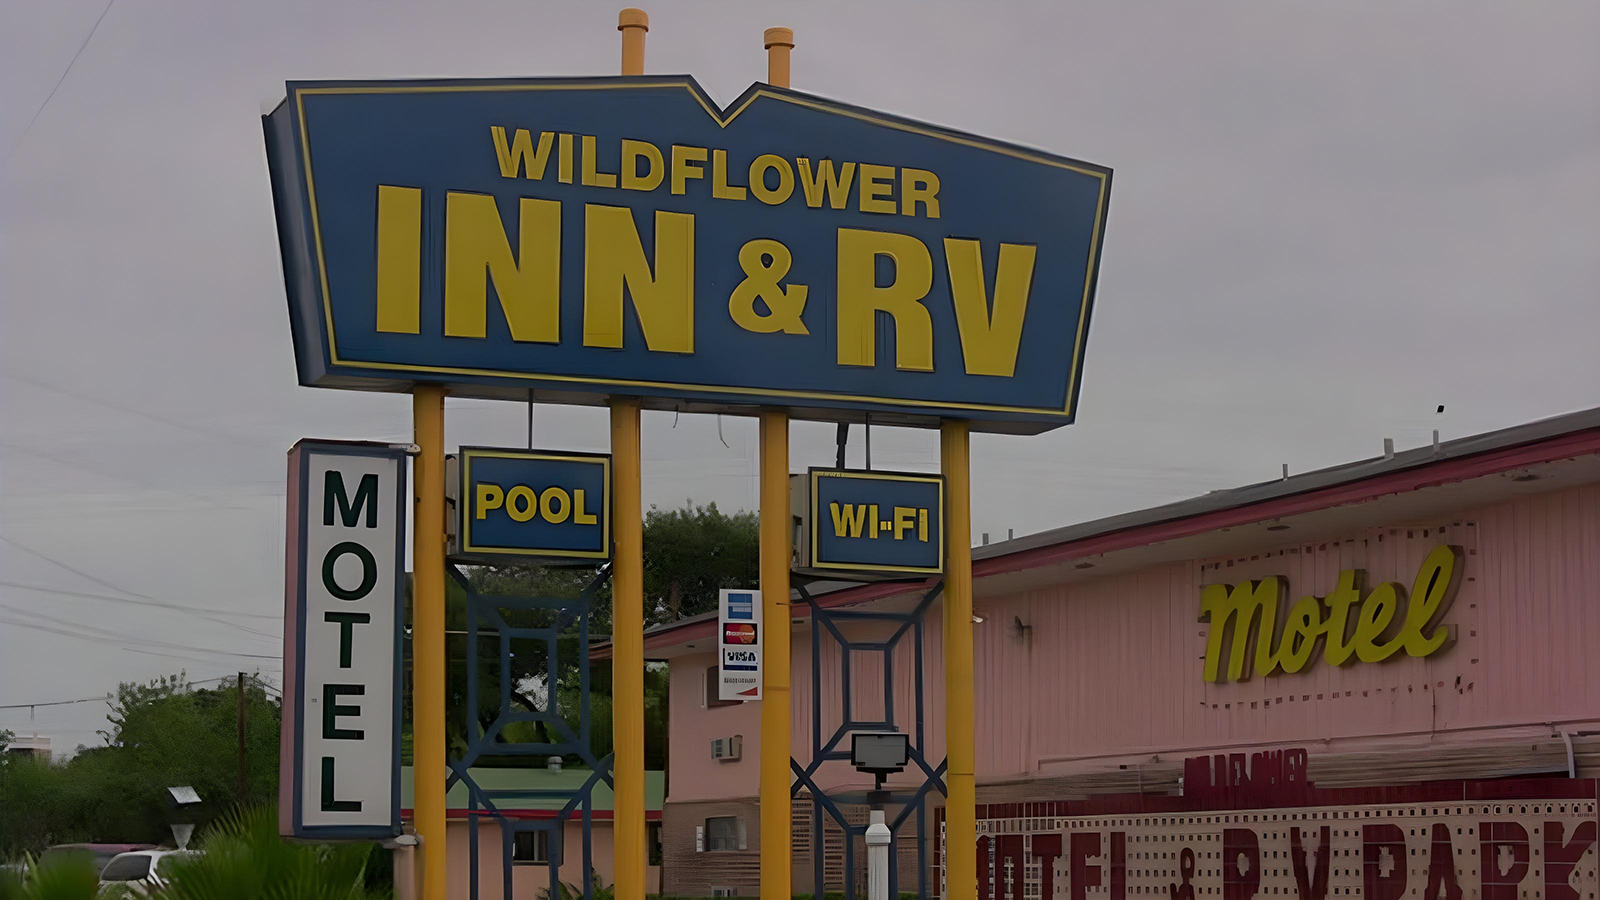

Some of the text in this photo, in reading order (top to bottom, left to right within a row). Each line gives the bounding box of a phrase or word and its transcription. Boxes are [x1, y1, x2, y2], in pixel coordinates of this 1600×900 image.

[490, 126, 941, 219] WILDFLOWER
[375, 184, 1038, 378] INN & RV
[475, 484, 598, 525] POOL
[829, 502, 929, 543] WI-FI
[321, 469, 379, 812] MOTEL
[1200, 544, 1455, 683] Motel
